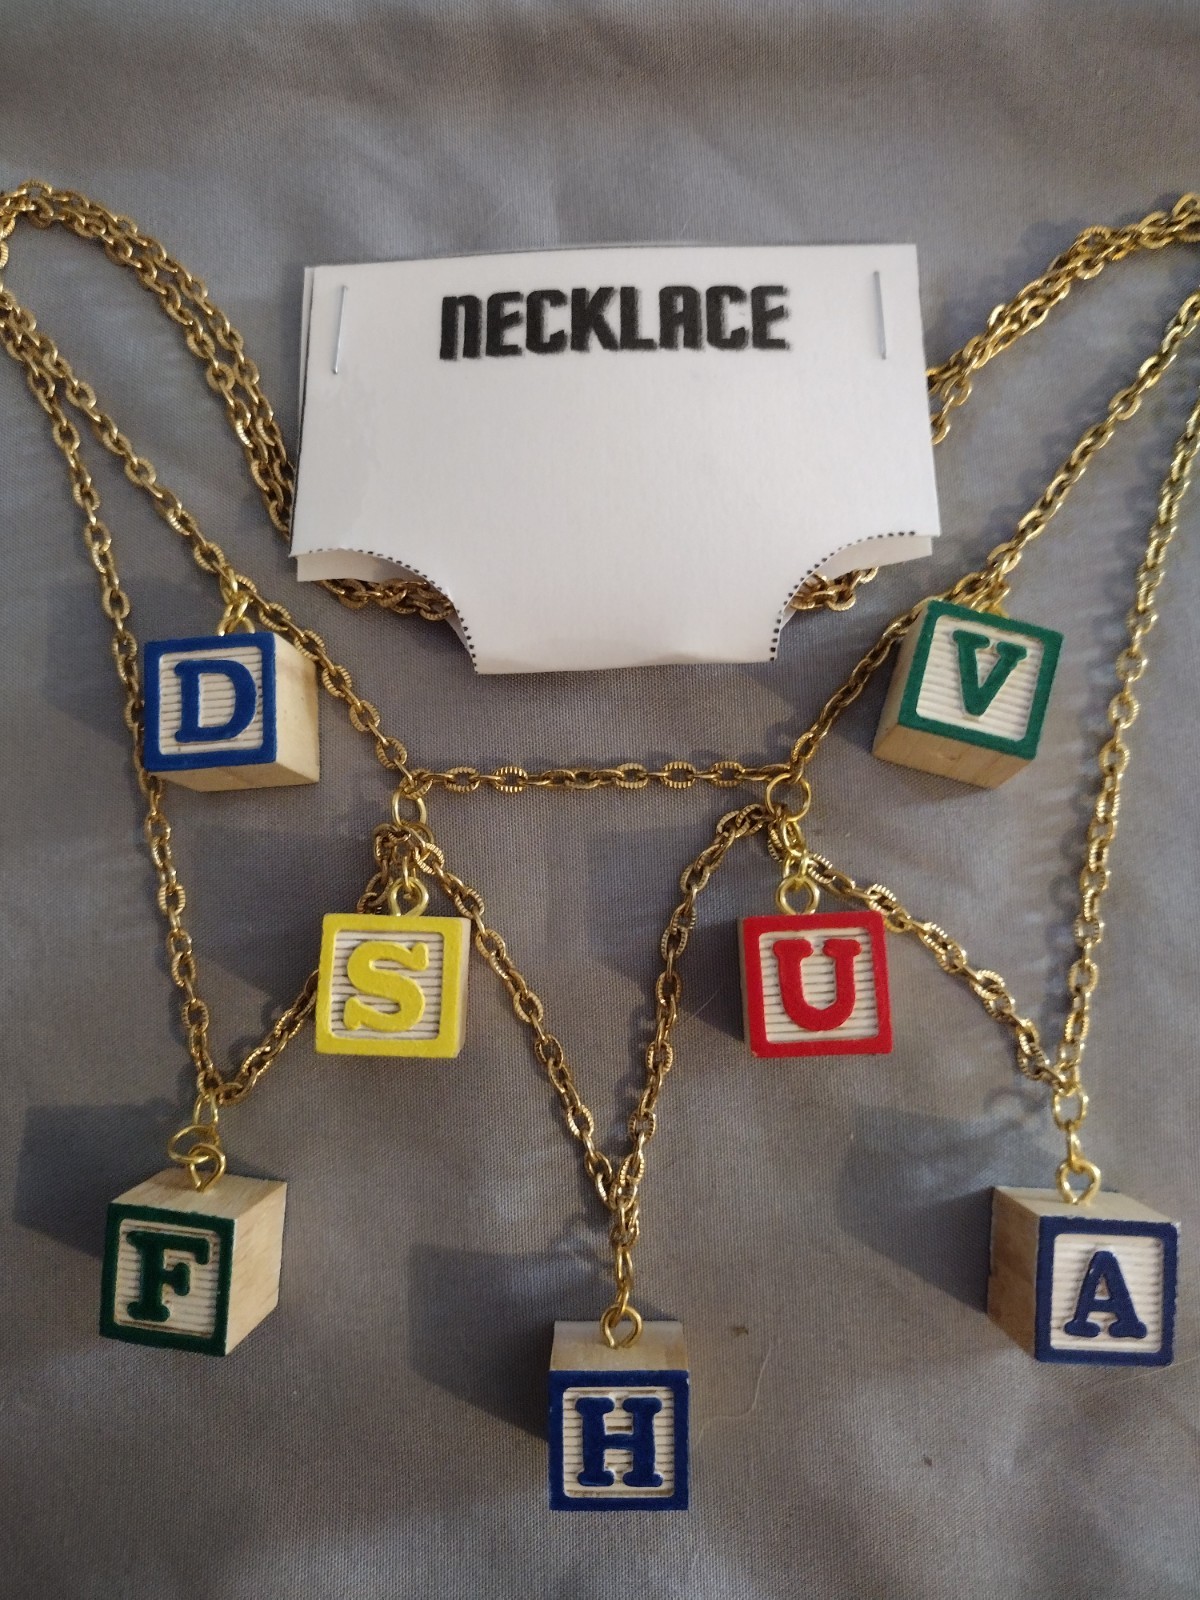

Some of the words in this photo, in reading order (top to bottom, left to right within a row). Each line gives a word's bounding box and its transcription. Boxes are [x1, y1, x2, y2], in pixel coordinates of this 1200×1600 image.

[440, 285, 791, 360] NECKLACE
[175, 660, 256, 743] D
[953, 629, 1028, 716] V
[344, 940, 429, 1031] S
[773, 939, 861, 1031] U
[127, 1231, 210, 1322] F
[1064, 1251, 1147, 1339] A
[576, 1397, 662, 1487] H
